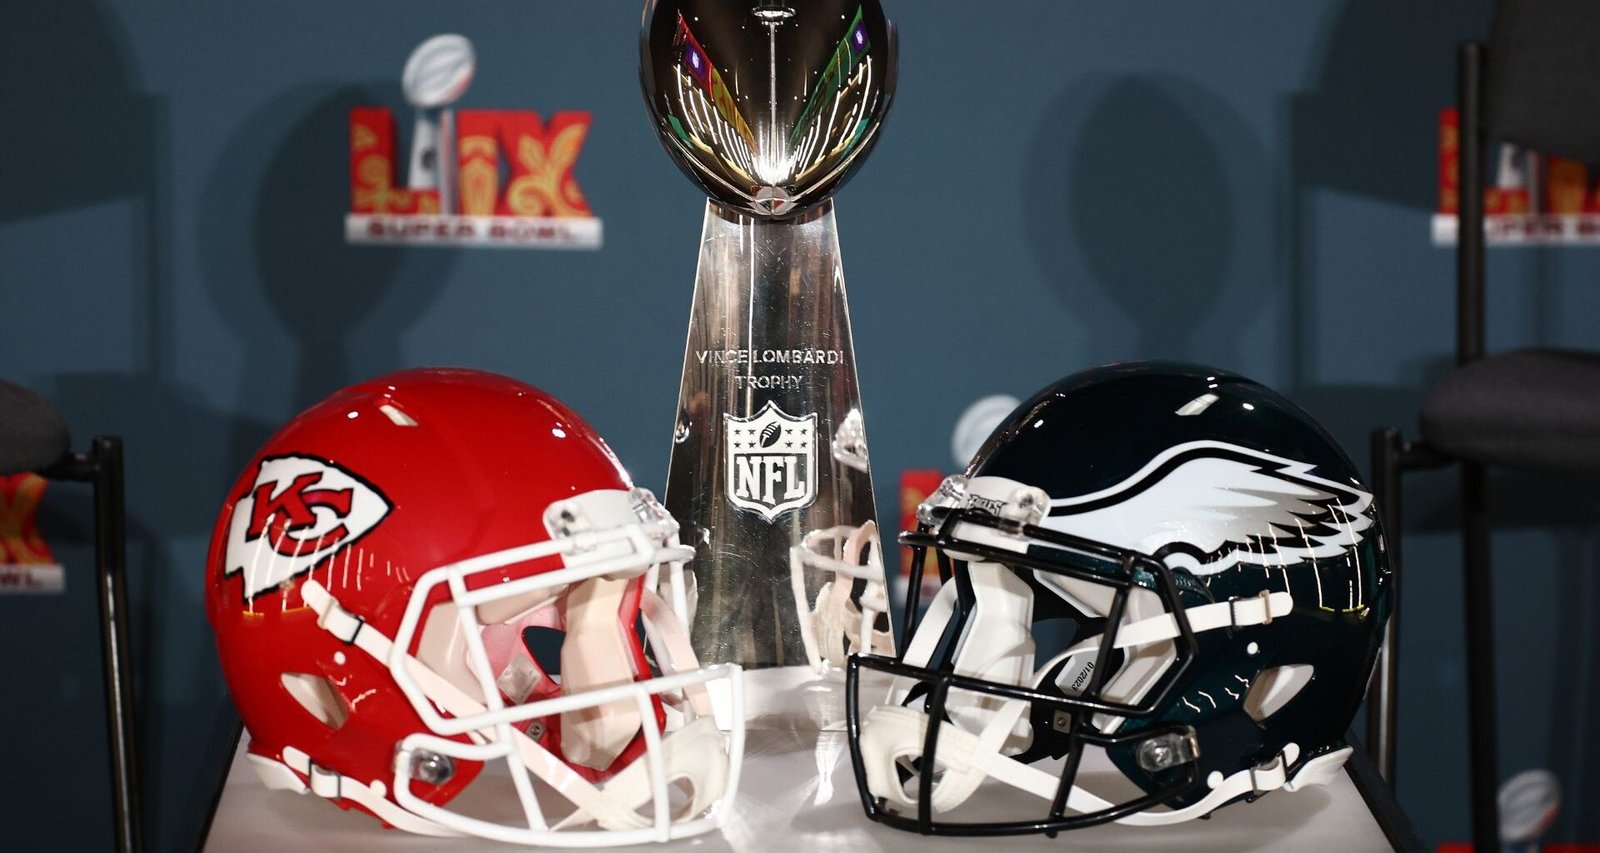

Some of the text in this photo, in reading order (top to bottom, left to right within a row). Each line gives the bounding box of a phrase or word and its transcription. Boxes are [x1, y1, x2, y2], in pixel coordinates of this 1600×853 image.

[368, 221, 574, 241] SUPER BOWL
[696, 349, 844, 364] VINCE LOMBARDI
[735, 375, 803, 389] TROPHY
[735, 455, 806, 506] NFL
[245, 471, 355, 557] KC
[1071, 661, 1095, 691] 01/2023
